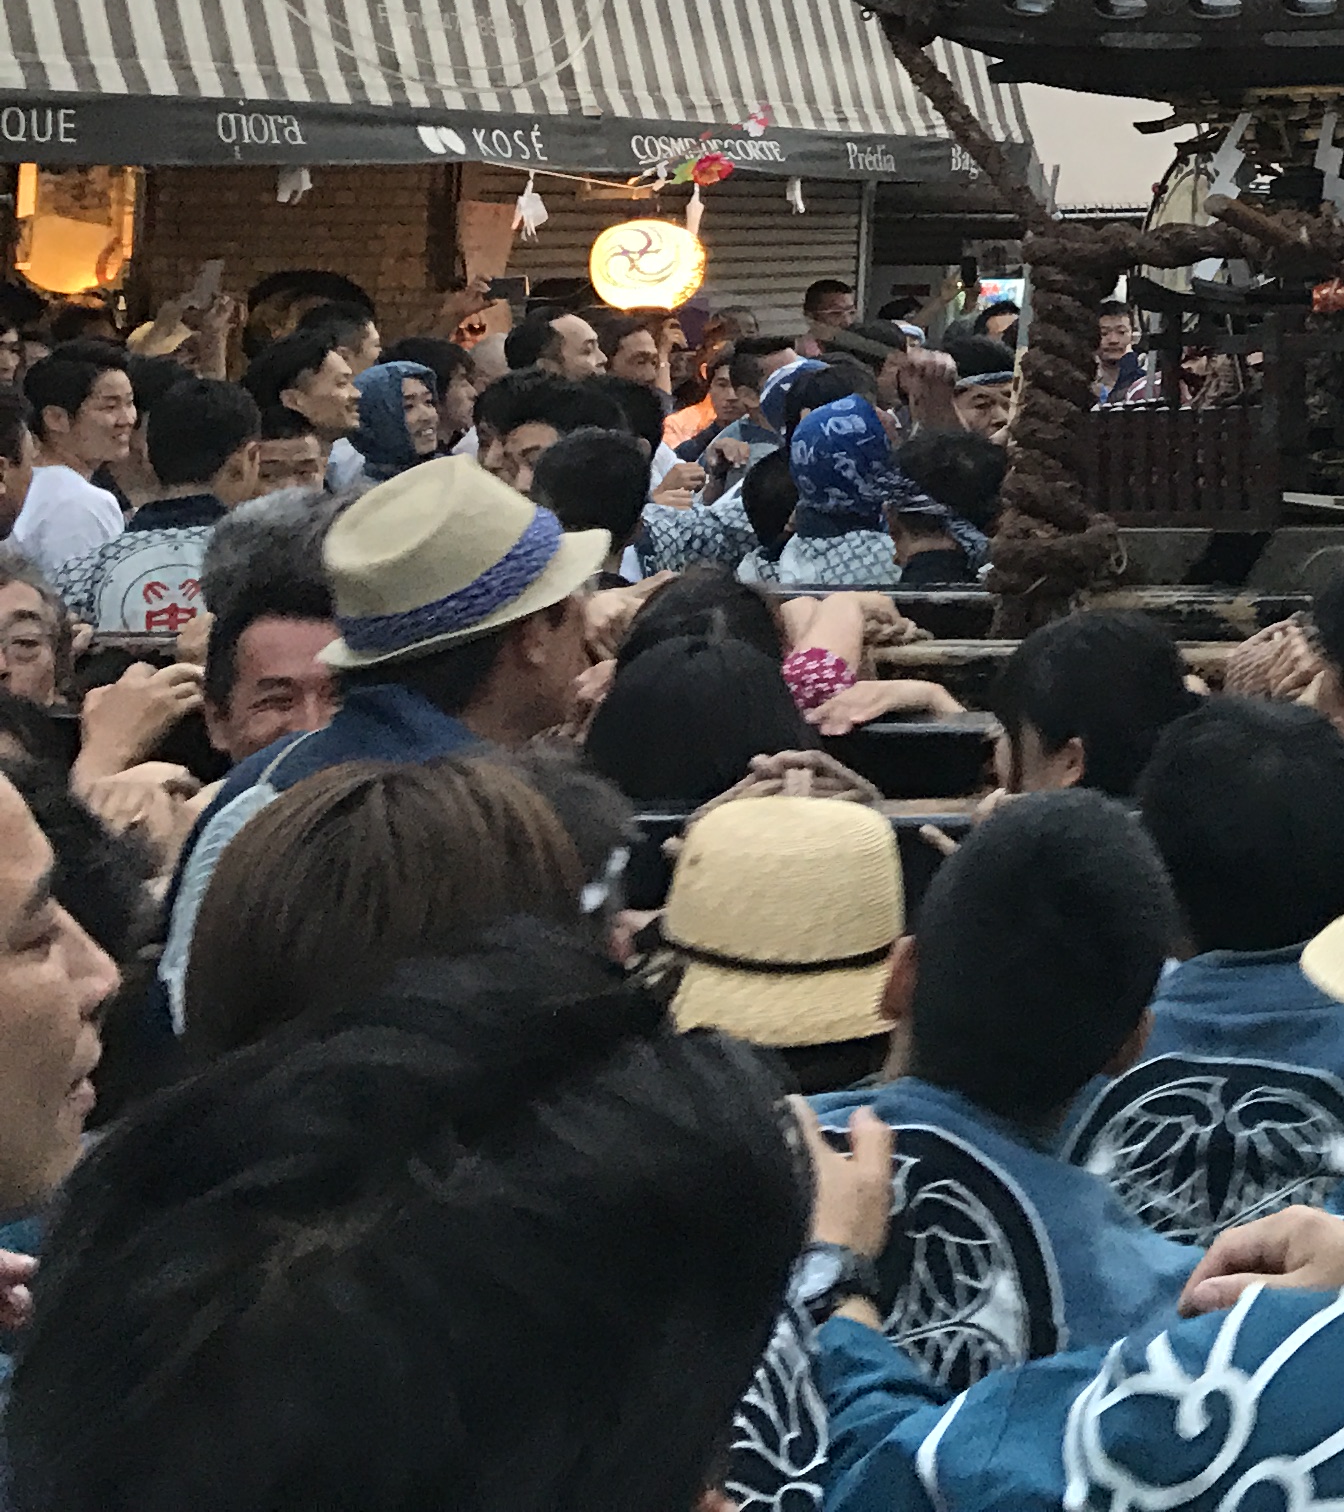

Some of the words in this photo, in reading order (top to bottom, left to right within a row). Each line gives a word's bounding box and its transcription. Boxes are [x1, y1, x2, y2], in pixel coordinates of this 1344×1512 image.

[1, 107, 77, 144] QUE
[472, 124, 548, 162] KOSÉ
[847, 141, 895, 174] Prédia
